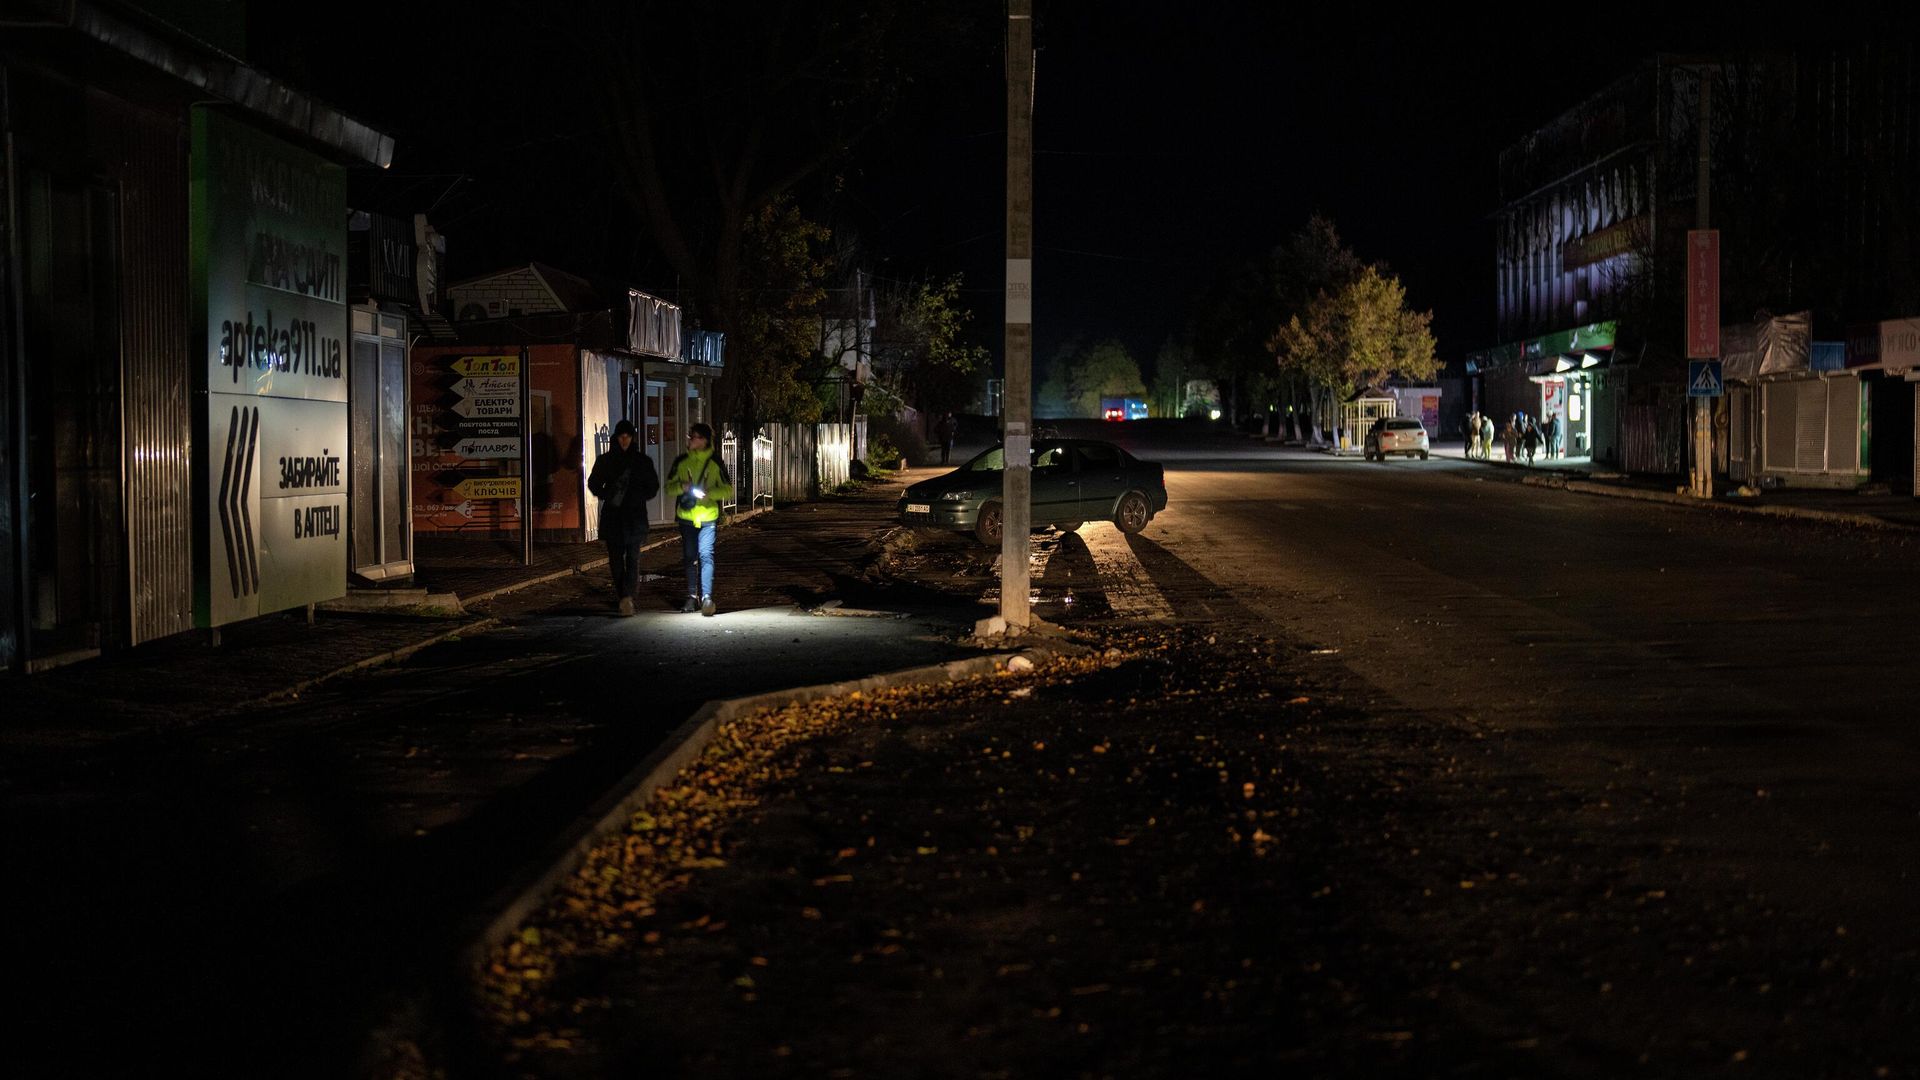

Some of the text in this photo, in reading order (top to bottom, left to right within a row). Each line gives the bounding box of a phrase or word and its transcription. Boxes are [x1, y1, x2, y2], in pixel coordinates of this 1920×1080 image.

[221, 309, 341, 383] apteka911.ua
[474, 399, 514, 407] ЕЛЕКТРО
[476, 407, 512, 415] ТОВАРИ
[279, 448, 340, 489] ЗАБИРАЙТЕ
[474, 488, 517, 496] КЛЮЧІВ
[294, 505, 340, 540] В АПТЕЦІ
